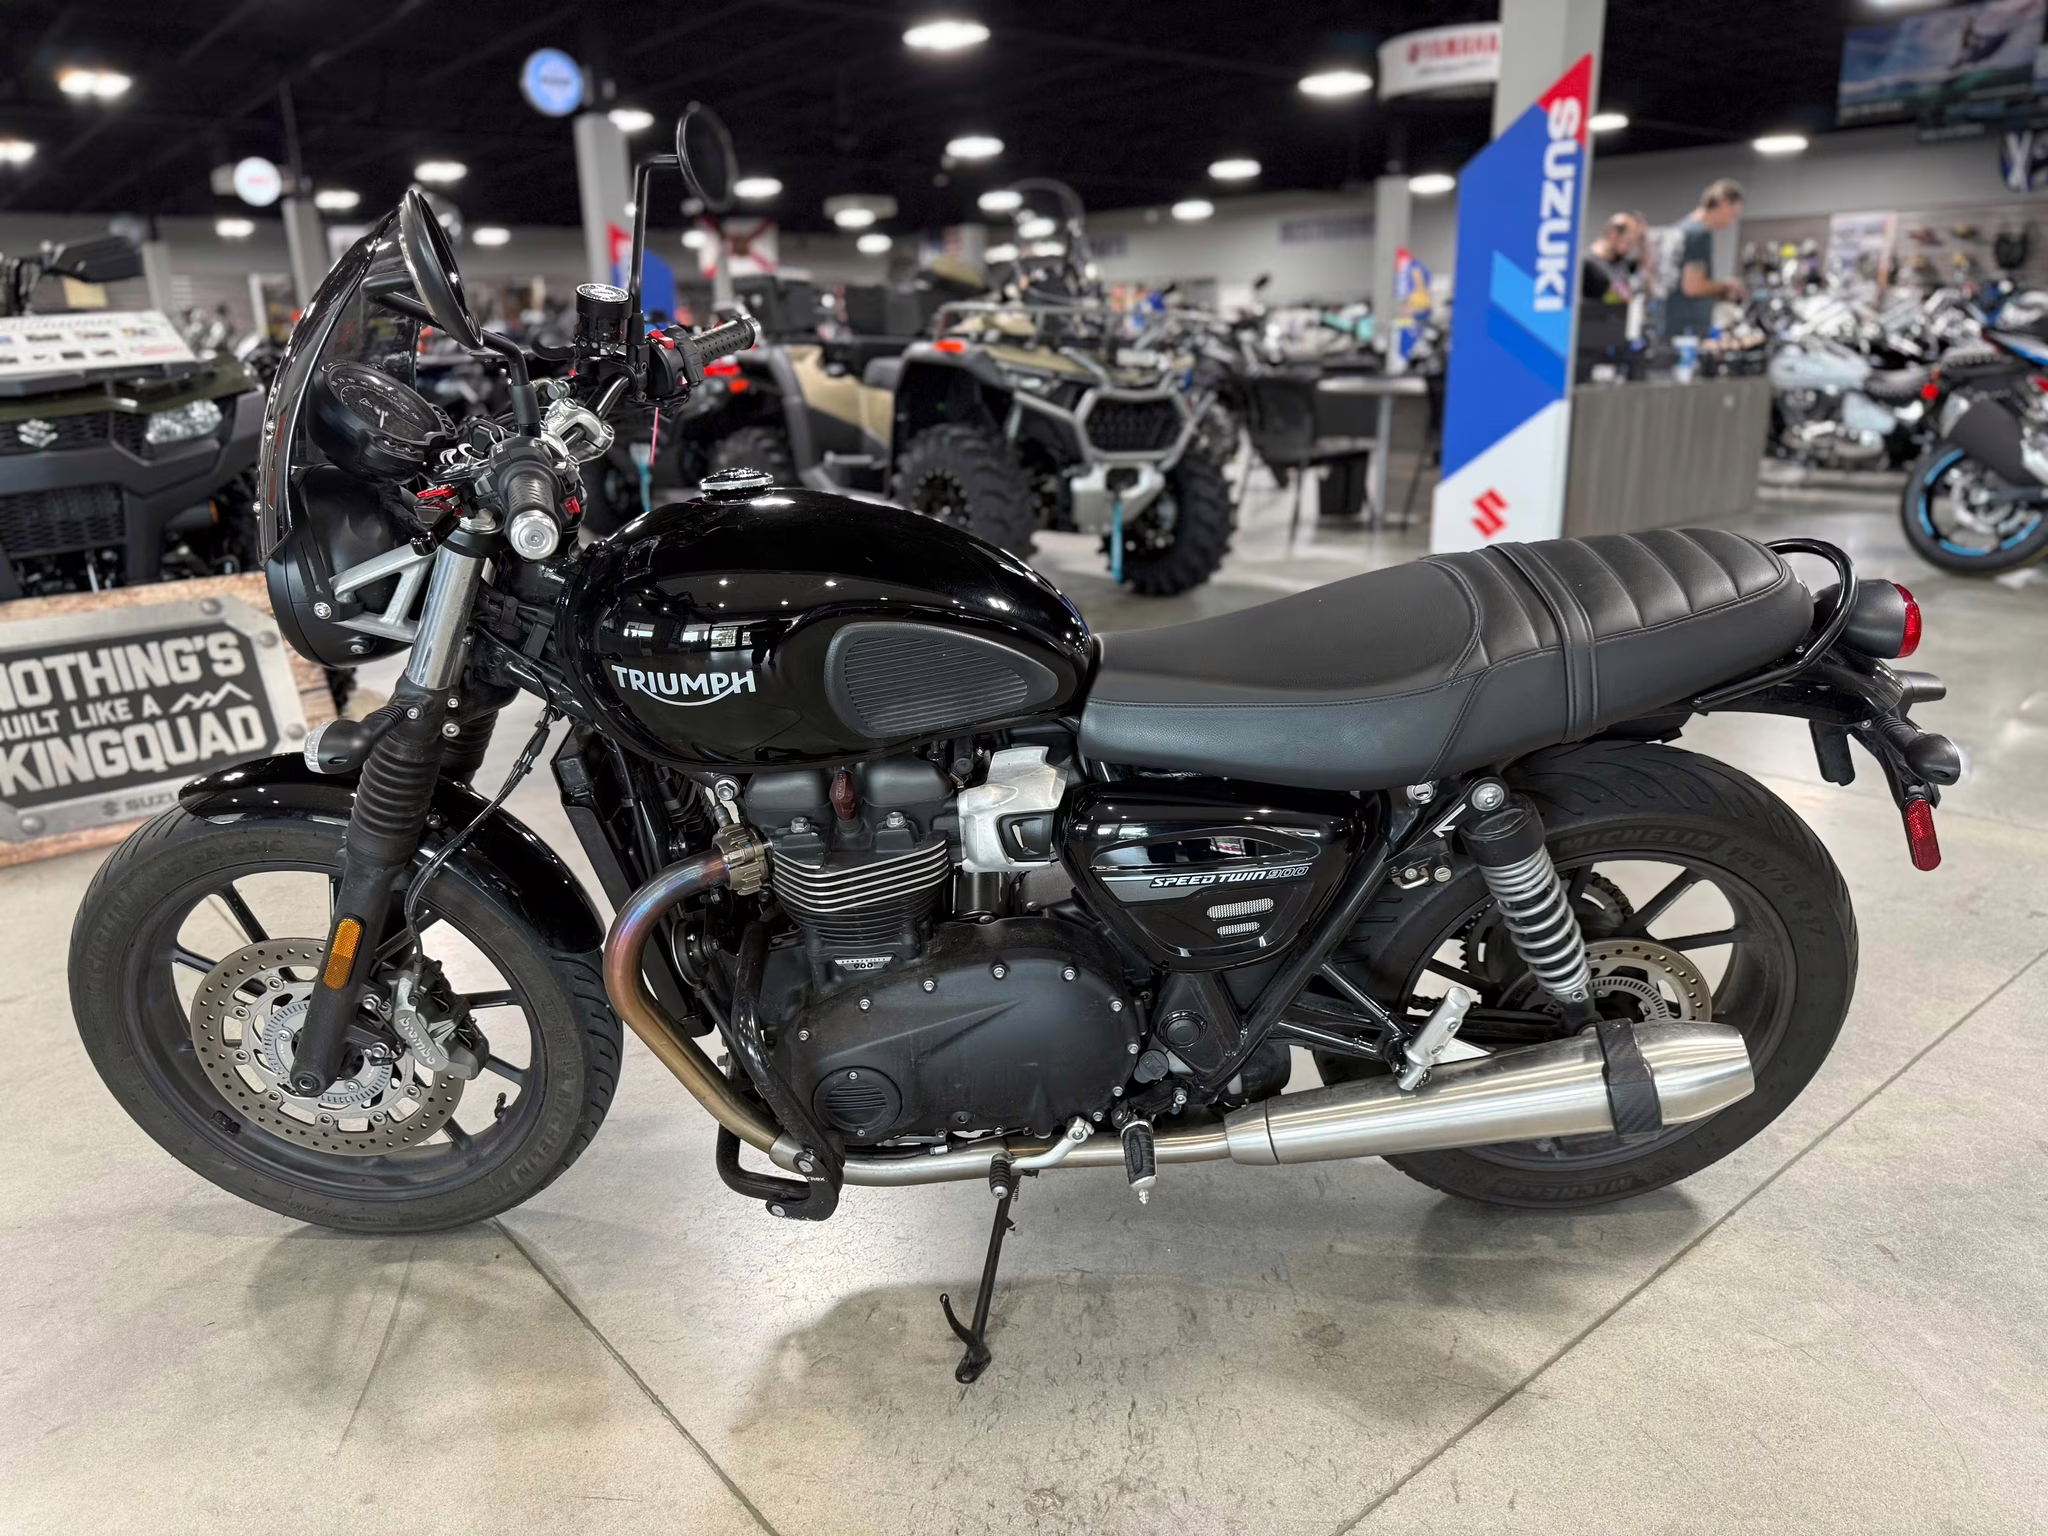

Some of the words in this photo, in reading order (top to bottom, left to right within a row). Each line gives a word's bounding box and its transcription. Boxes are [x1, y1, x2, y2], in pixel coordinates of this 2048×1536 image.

[1534, 96, 1582, 313] SUZUKI
[611, 664, 757, 707] TRIUMPH
[0, 708, 60, 742] UILT
[70, 697, 133, 730] LIKE
[142, 693, 163, 719] A
[0, 704, 268, 797] KINGQUAD
[1558, 828, 1721, 855] MICHELIN
[1151, 875, 1216, 888] SPEED
[1218, 871, 1266, 884] TWIN
[1266, 866, 1309, 879] 900
[1727, 846, 1799, 895] 150/70
[398, 1016, 436, 1065] brembo
